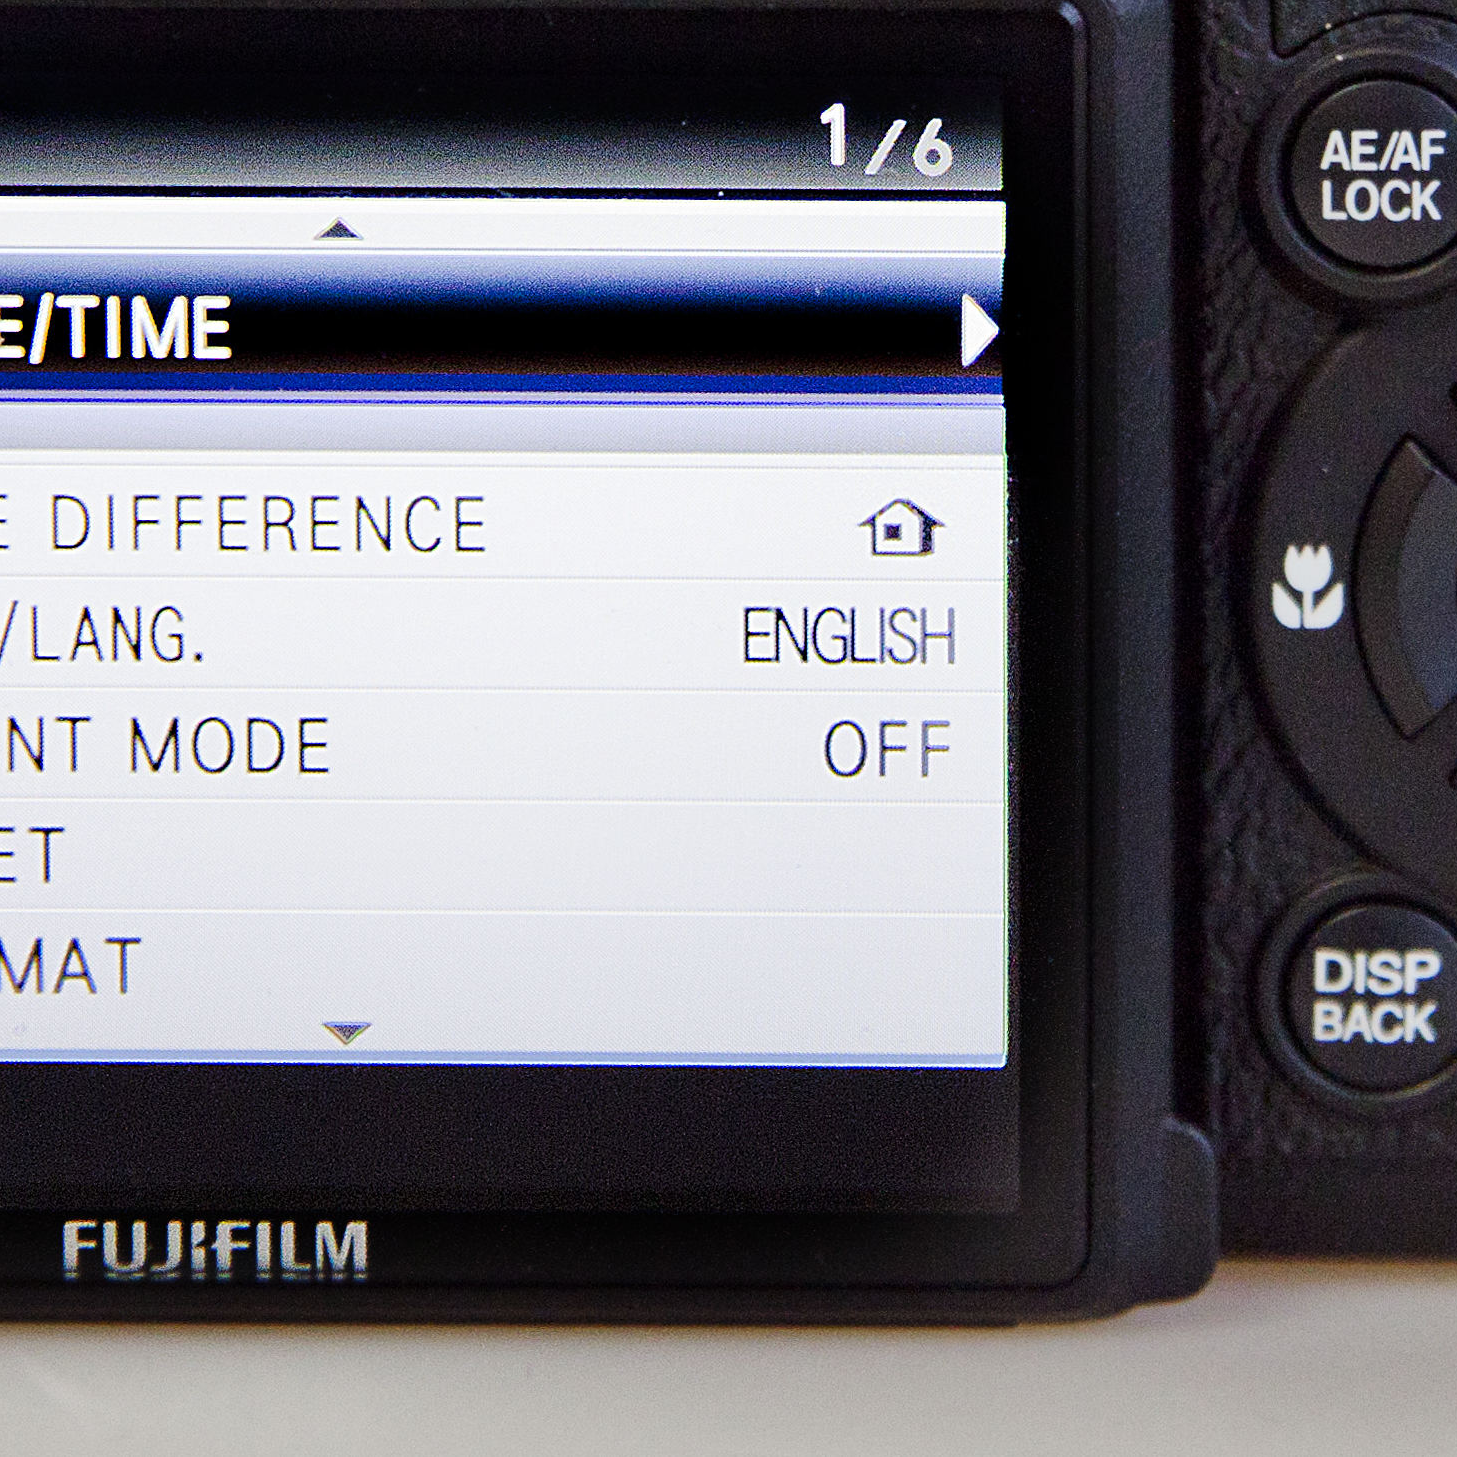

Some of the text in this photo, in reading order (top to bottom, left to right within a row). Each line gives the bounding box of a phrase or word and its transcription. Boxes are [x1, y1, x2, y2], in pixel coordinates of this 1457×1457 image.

[819, 103, 955, 178] 1/6
[1319, 129, 1448, 173] AE/AF
[1321, 179, 1443, 223] LOCK
[51, 495, 487, 553] DIFFERENCE
[743, 606, 955, 665] ENGLISH
[130, 717, 331, 775] MODE
[824, 719, 951, 779] OFF
[1313, 949, 1442, 995] DISP
[1313, 1003, 1437, 1045] BACK
[62, 1219, 371, 1280] FUJIFILM
